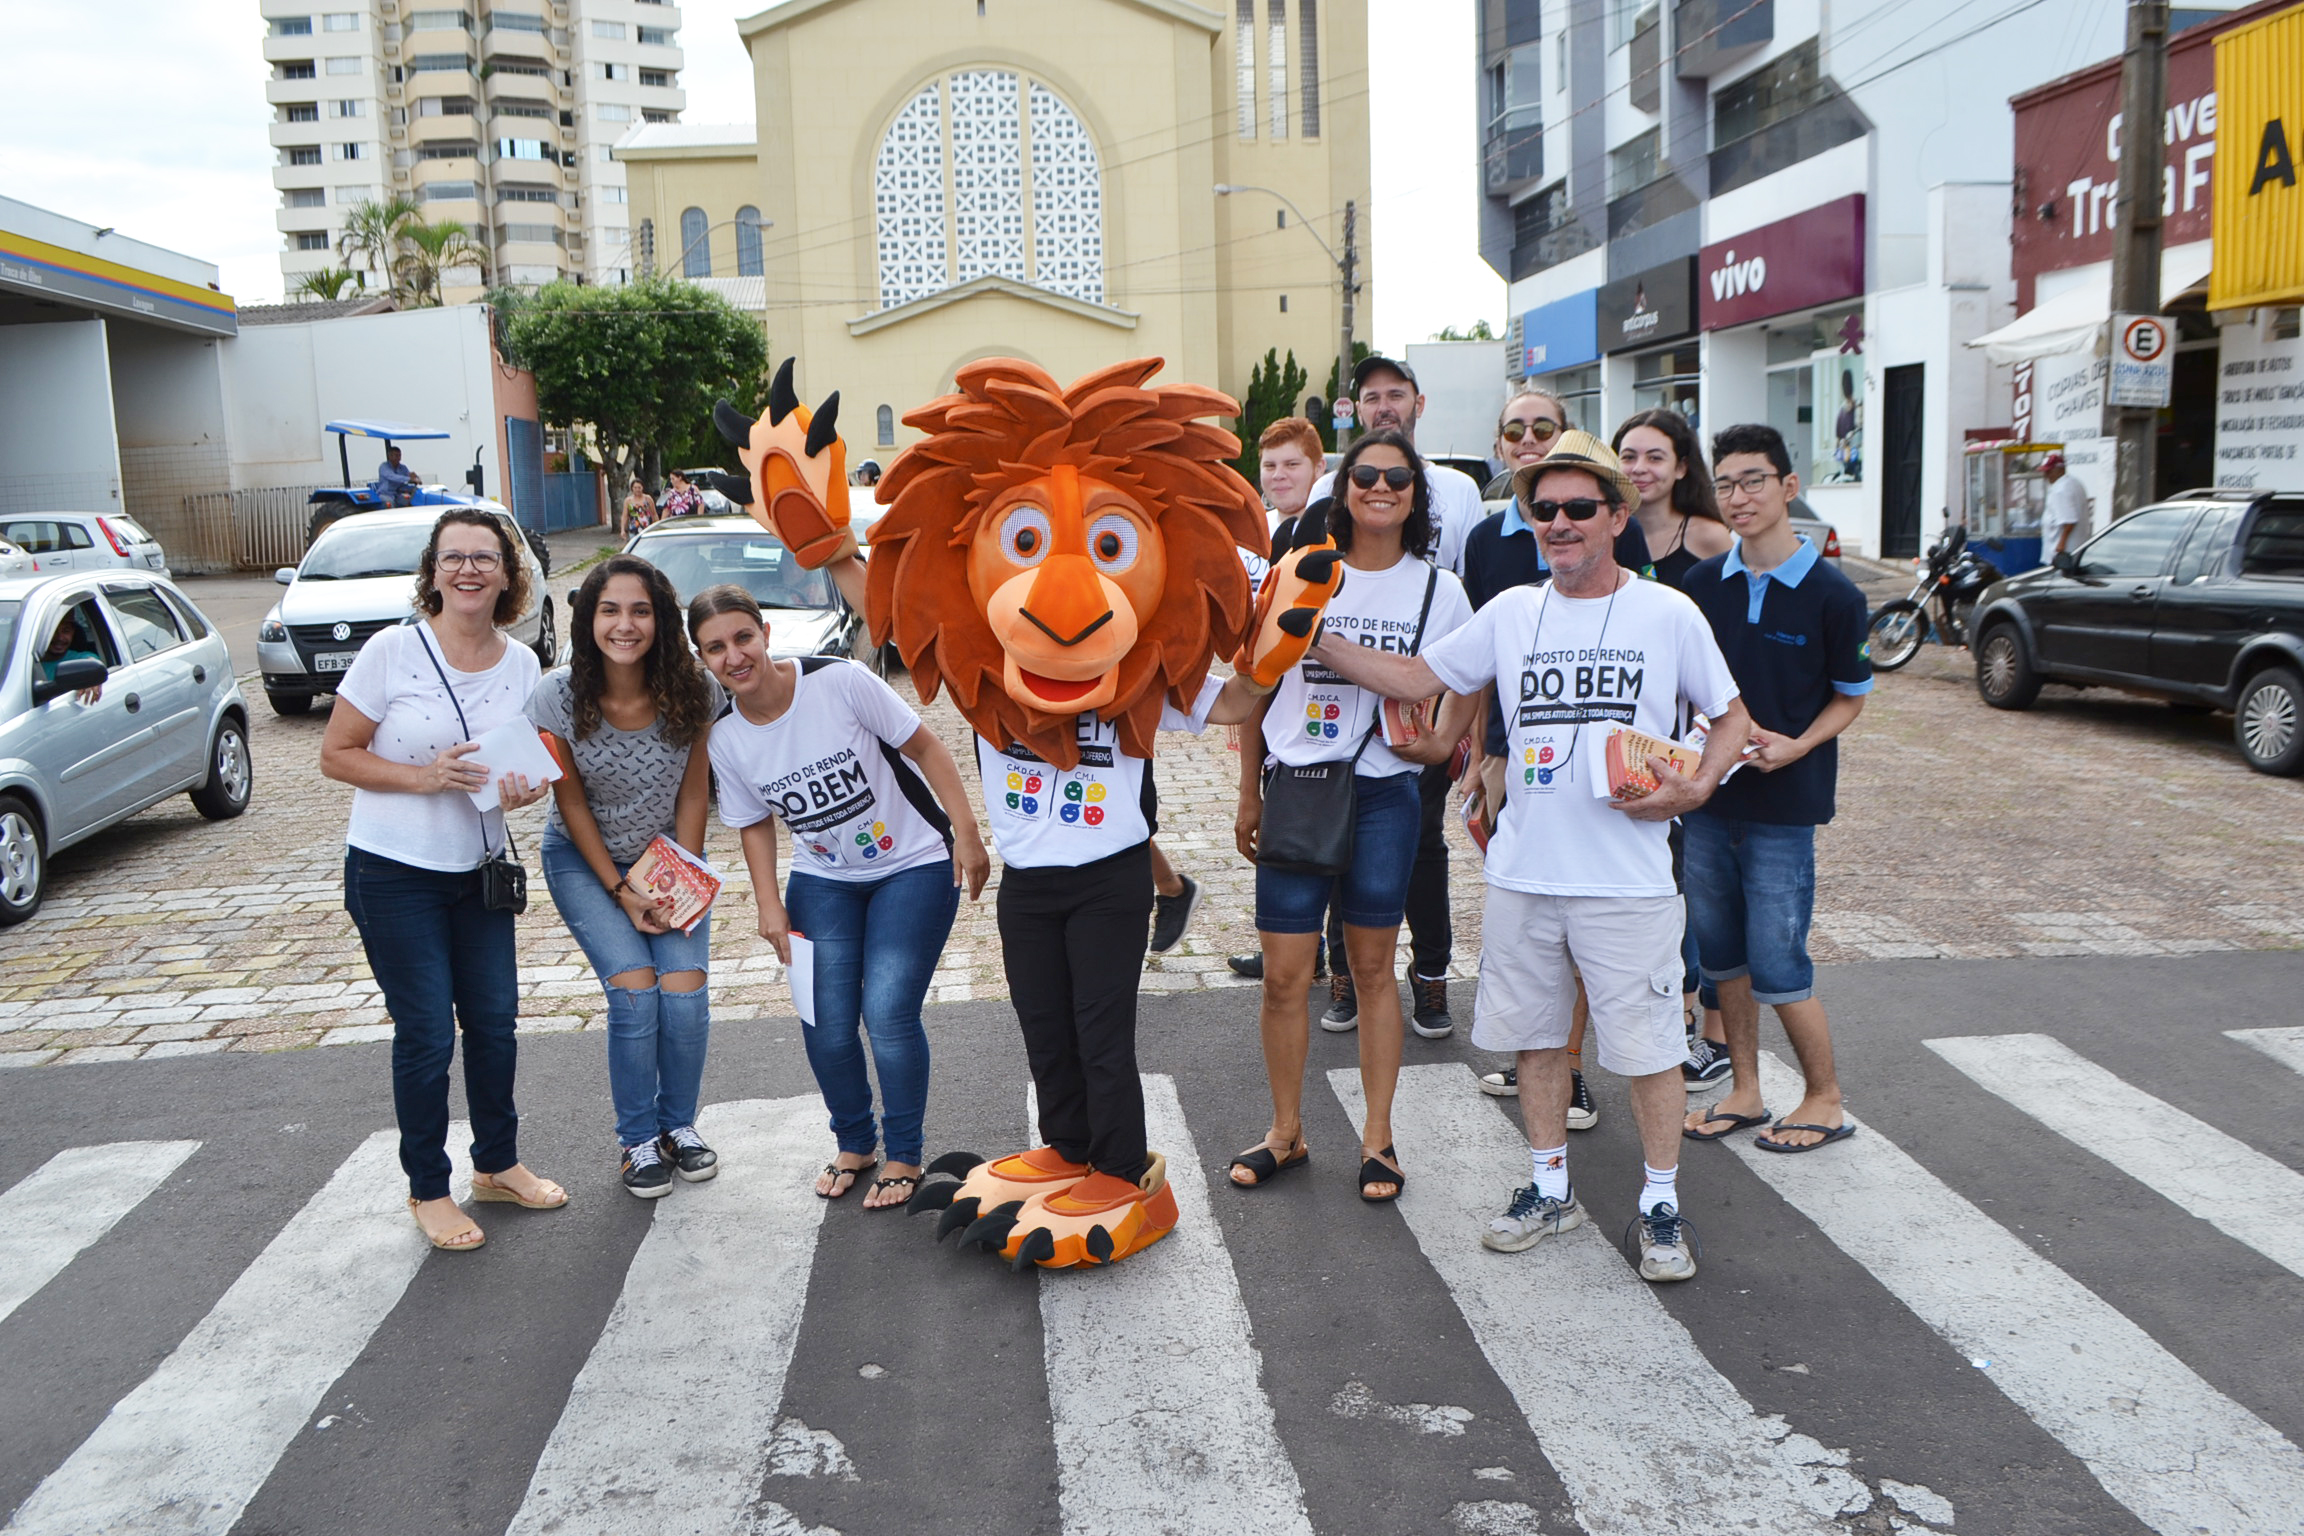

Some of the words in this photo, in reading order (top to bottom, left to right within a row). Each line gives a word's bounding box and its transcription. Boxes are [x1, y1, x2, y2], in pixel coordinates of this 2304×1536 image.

[2067, 165, 2176, 239] Traa
[1710, 250, 1766, 302] vivo
[2136, 328, 2152, 351] E
[1362, 618, 1378, 631] DE
[1381, 620, 1418, 635] RENDA
[1522, 650, 1575, 667] IMPOSTO
[1578, 649, 1596, 662] DE
[1599, 648, 1645, 665] RENDA
[1520, 667, 1564, 703] DO
[1575, 665, 1644, 701] BEM
[1076, 709, 1117, 744] EM
[758, 771, 802, 797] IMPOSTO
[801, 764, 815, 779] DE
[817, 748, 856, 773] RENDA
[807, 759, 869, 810] BEM
[1006, 763, 1044, 778] C.M.D.C.A.
[1074, 771, 1096, 783] C.M.I.
[823, 815, 834, 826] FAZ
[834, 810, 849, 822] TODA
